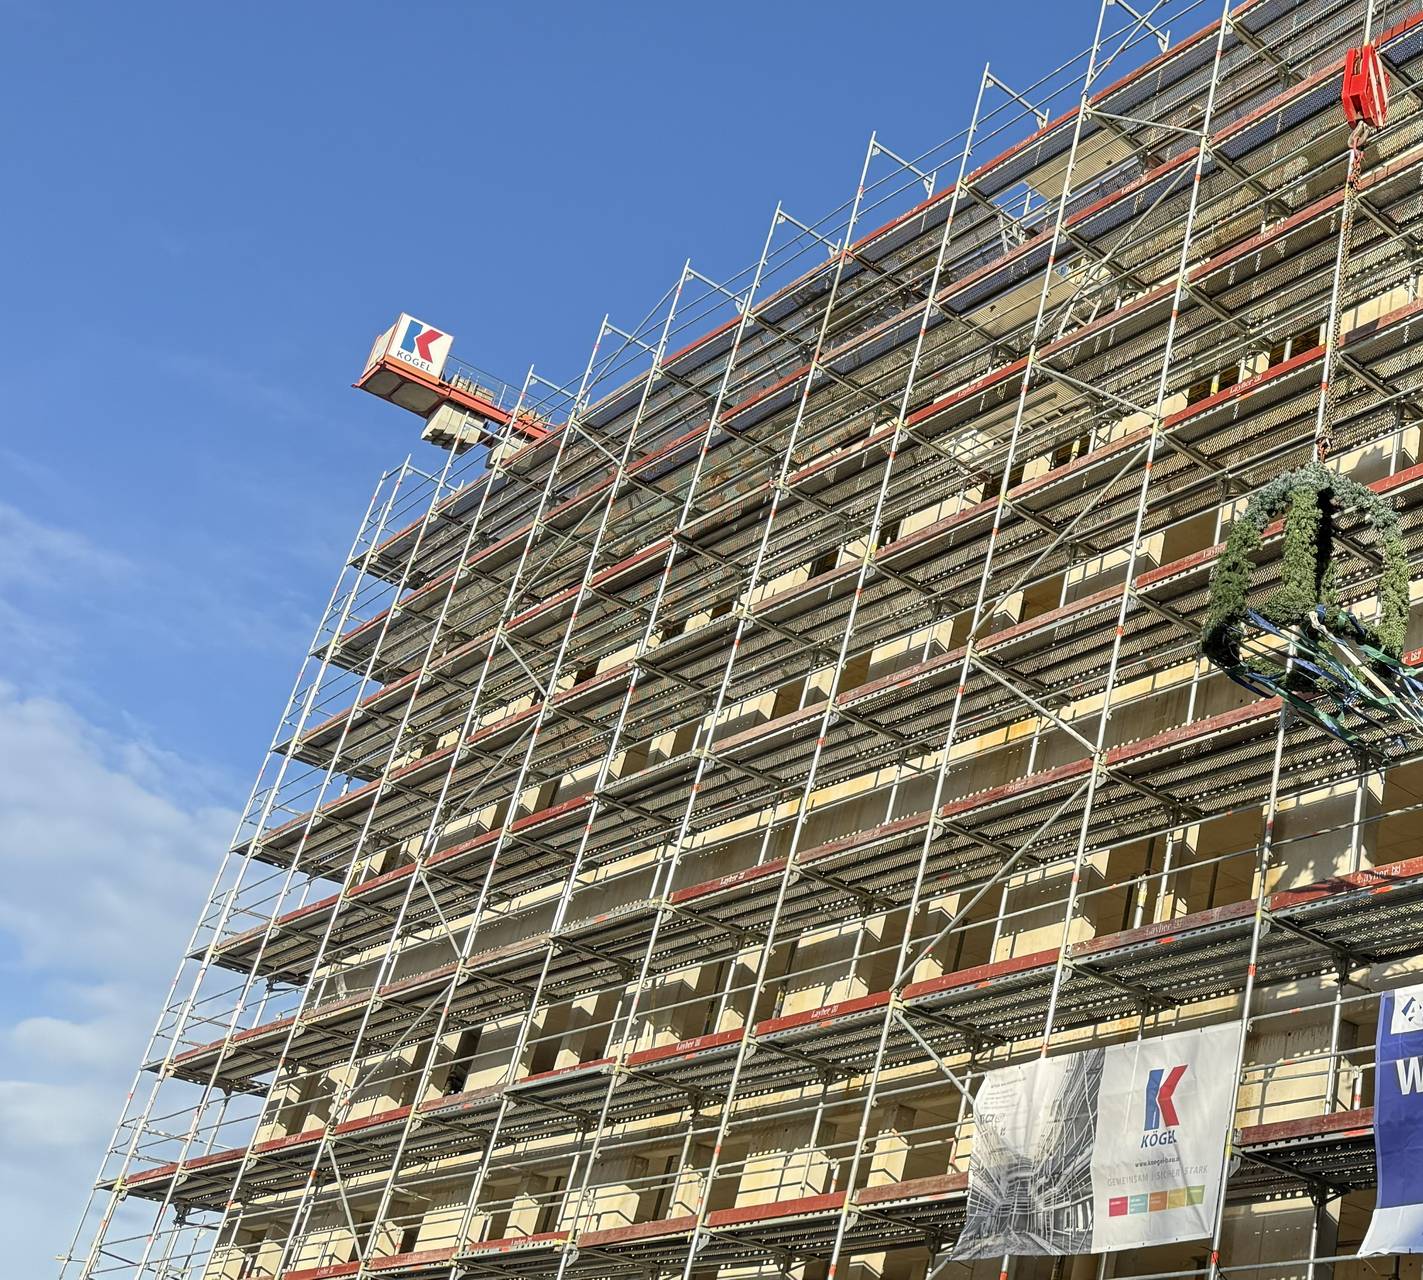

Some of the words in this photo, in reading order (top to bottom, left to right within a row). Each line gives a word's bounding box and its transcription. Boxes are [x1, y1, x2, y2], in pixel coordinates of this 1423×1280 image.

[1140, 1129, 1178, 1149] KÖGEL
[1107, 1171, 1149, 1187] GEMEINSAM
[1183, 1165, 1209, 1176] STARK
